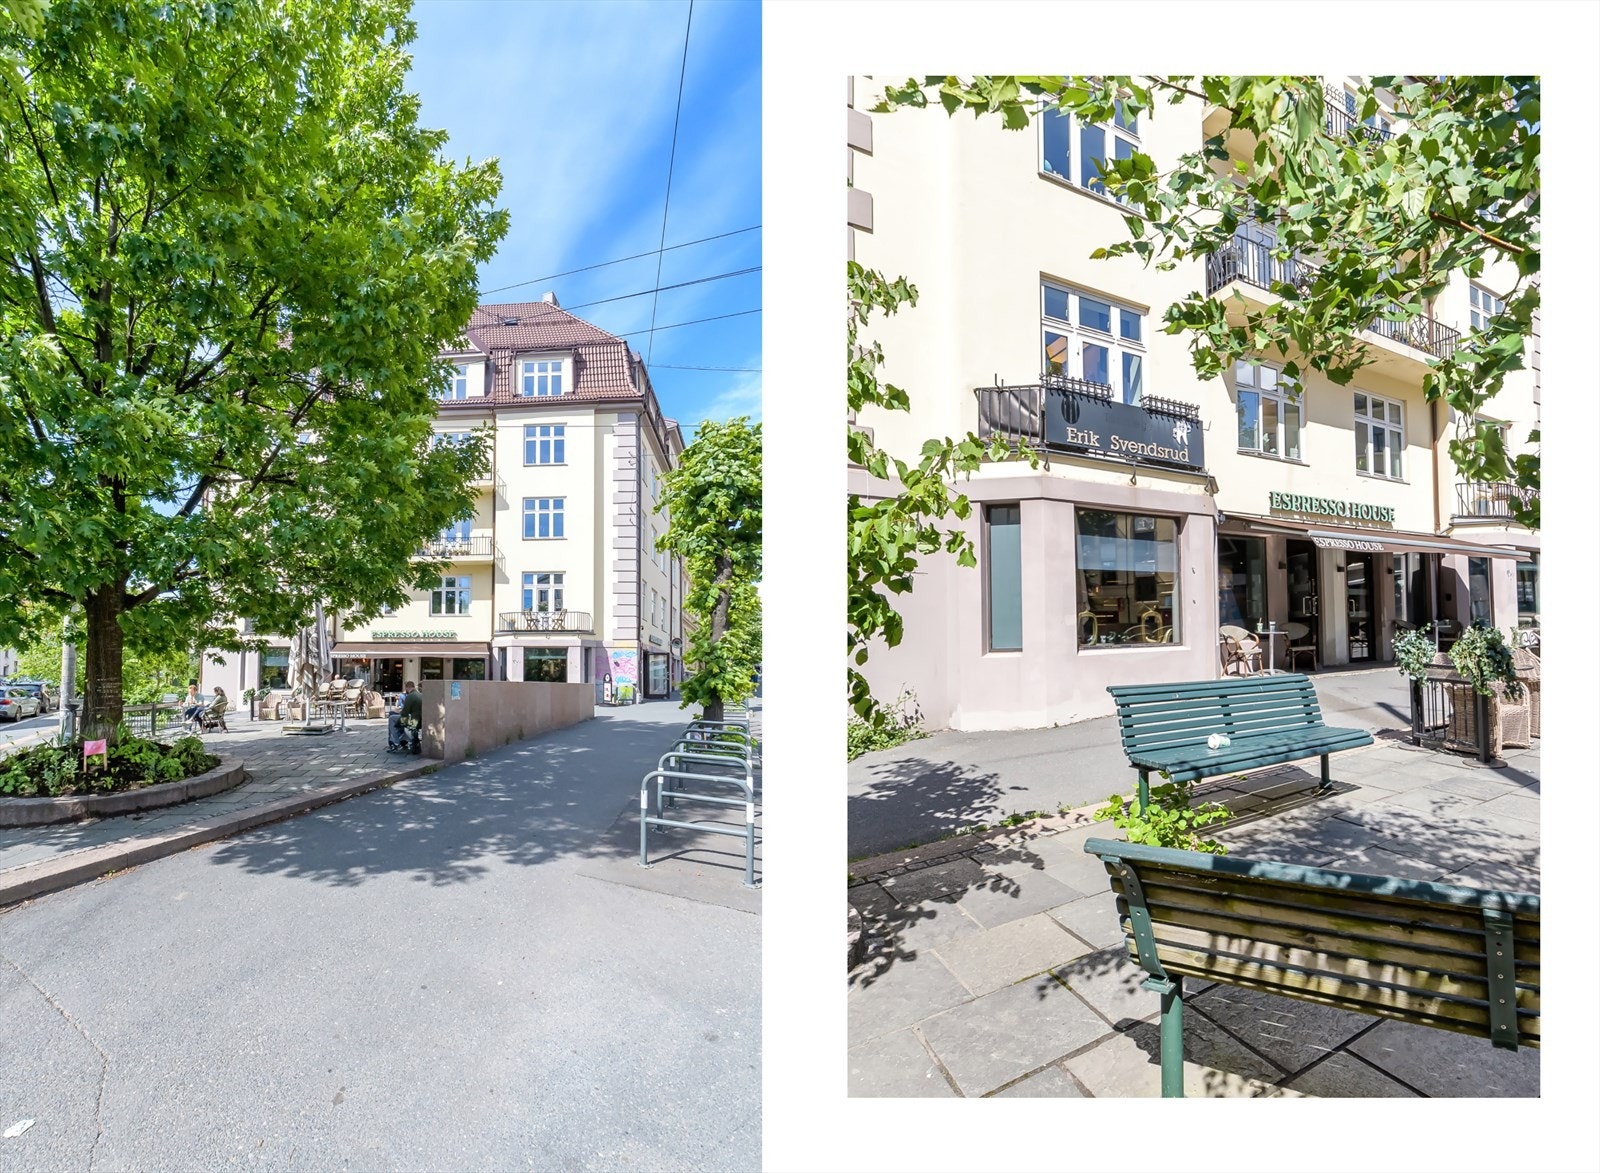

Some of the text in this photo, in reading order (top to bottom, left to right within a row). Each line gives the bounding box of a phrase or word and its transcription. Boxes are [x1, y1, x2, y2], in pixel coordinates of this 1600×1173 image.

[1066, 427, 1190, 462] Erik Svendsrud
[1269, 491, 1395, 522] ESPRESSO HOUSE
[1314, 537, 1384, 551] ESPRESSO HOUSE
[372, 630, 457, 638] ESPRESSO HOUSE
